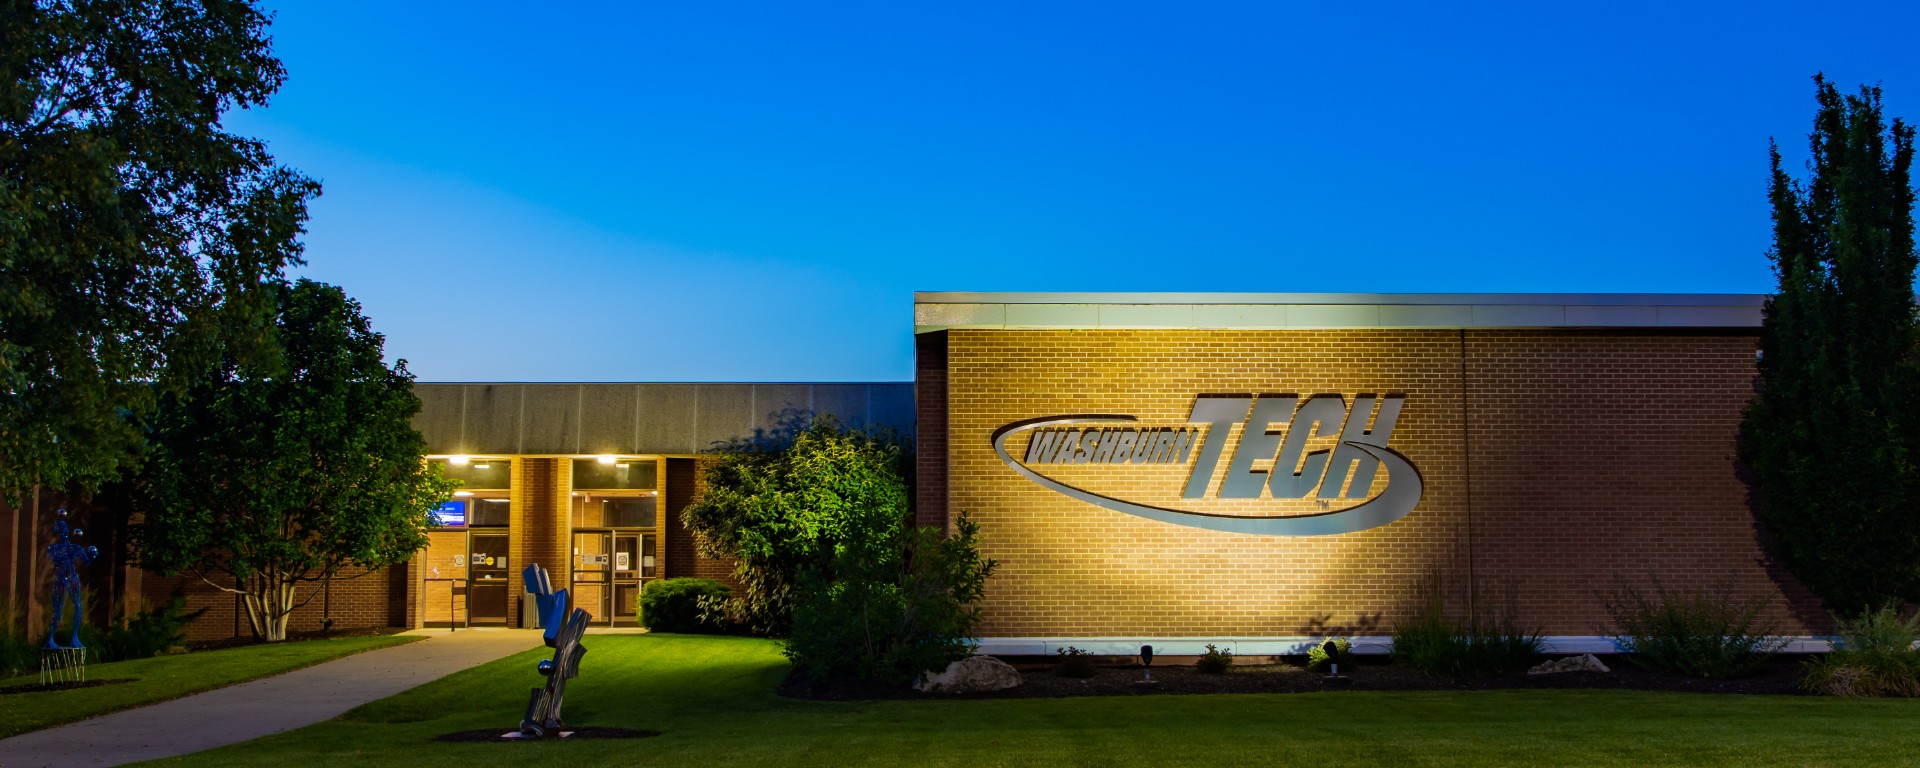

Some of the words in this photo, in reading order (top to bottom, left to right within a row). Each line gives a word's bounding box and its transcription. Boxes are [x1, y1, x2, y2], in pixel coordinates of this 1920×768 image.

[1025, 427, 1198, 464] WASHBURN
[1181, 393, 1407, 499] TECH
[1315, 500, 1330, 511] TM
